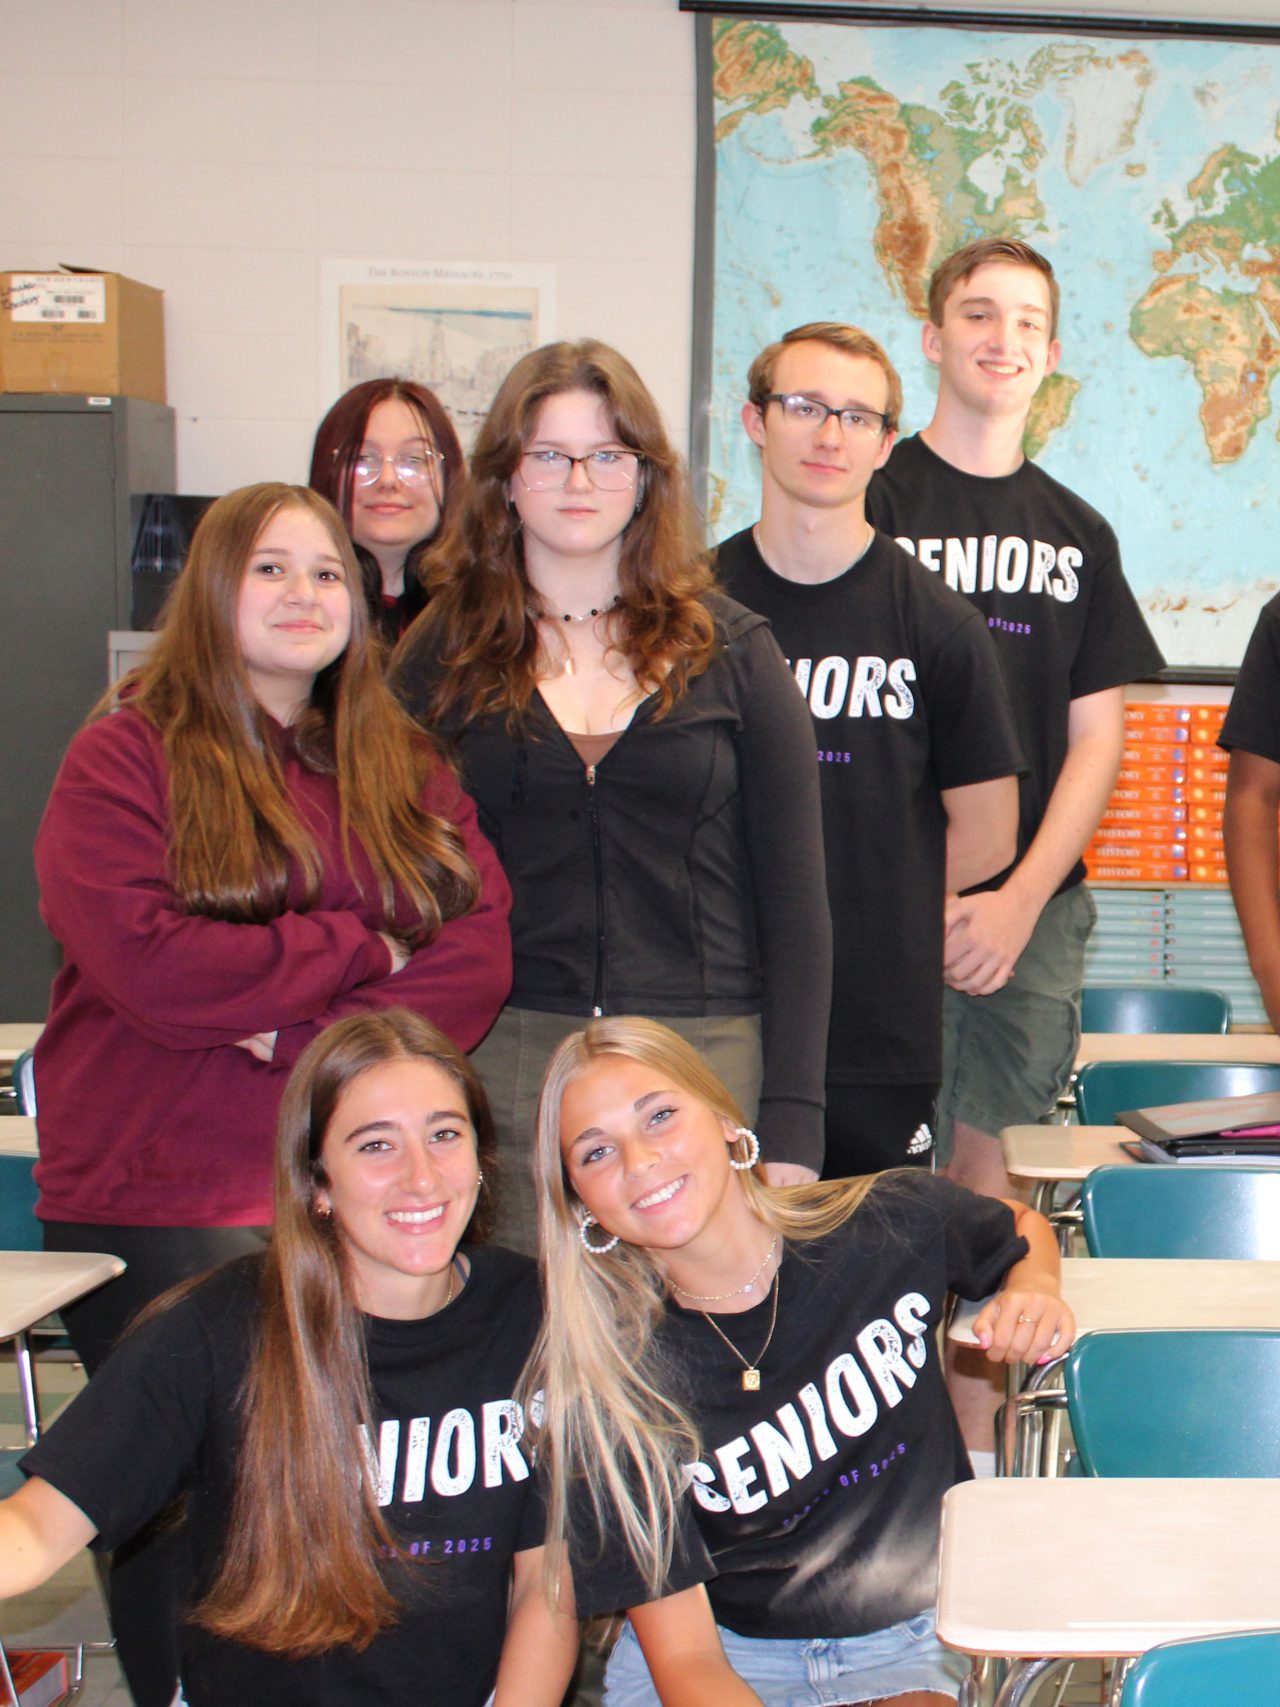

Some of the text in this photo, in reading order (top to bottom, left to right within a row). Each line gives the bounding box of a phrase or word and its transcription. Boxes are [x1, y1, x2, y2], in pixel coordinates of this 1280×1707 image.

[894, 535, 1084, 603] ENIORS
[988, 617, 1032, 635] OF 2025
[784, 655, 917, 720] IORS
[817, 750, 852, 763] 2025
[1096, 867, 1142, 877] HISTORY
[682, 1291, 932, 1516] SENIORS
[839, 1469, 860, 1488] OF
[410, 1541, 431, 1557] OF
[444, 1537, 493, 1555] 2025
